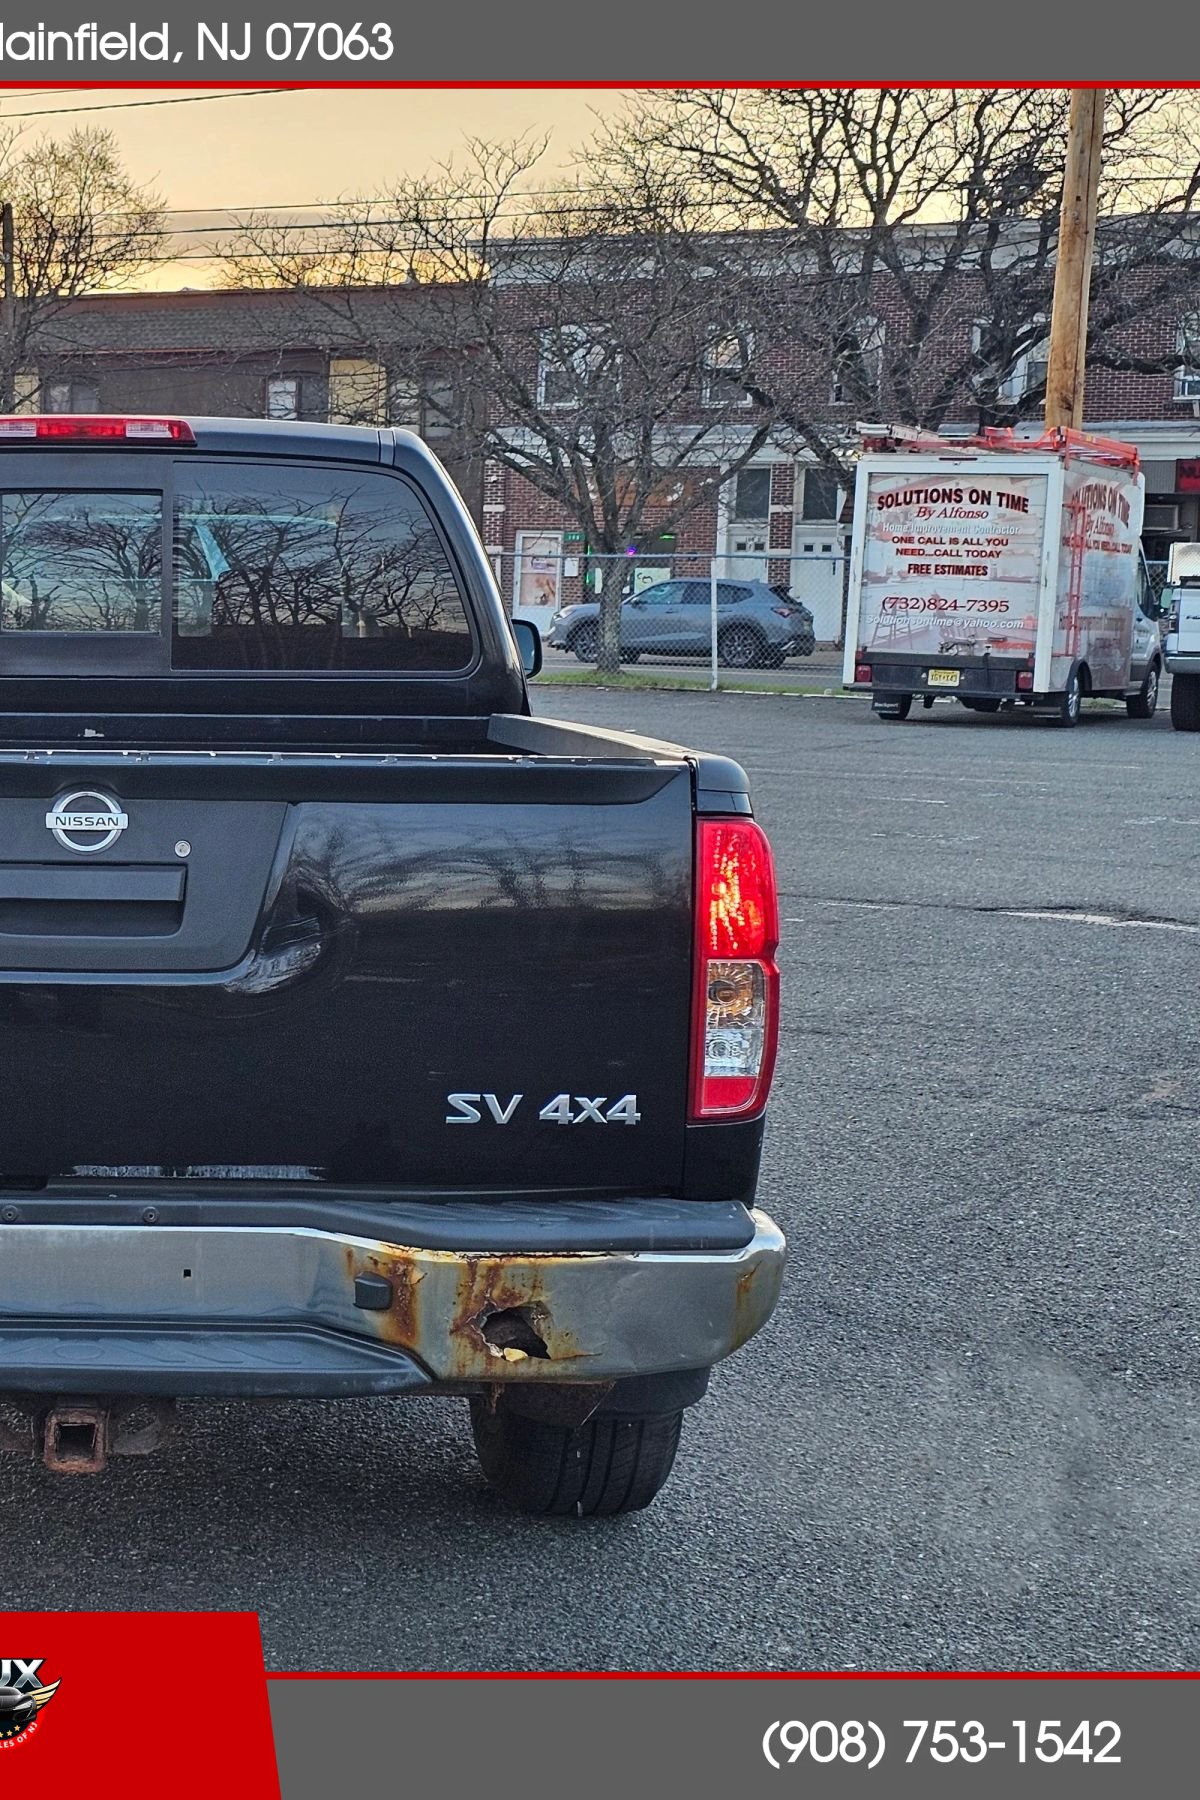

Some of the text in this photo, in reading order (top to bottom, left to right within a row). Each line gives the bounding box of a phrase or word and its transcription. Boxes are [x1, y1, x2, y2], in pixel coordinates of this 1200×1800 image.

[877, 488, 1030, 514] SOLUTIONS ON TIME
[915, 506, 990, 521] By Alfonso
[891, 536, 1009, 547] ONE CALL IS ALL YOU
[966, 549, 1002, 558] TODAY
[907, 564, 989, 577] FREE ESTIMATES
[882, 596, 1010, 613] (732)824-7395
[55, 816, 119, 826] NISSAN
[446, 1093, 524, 1124] SV
